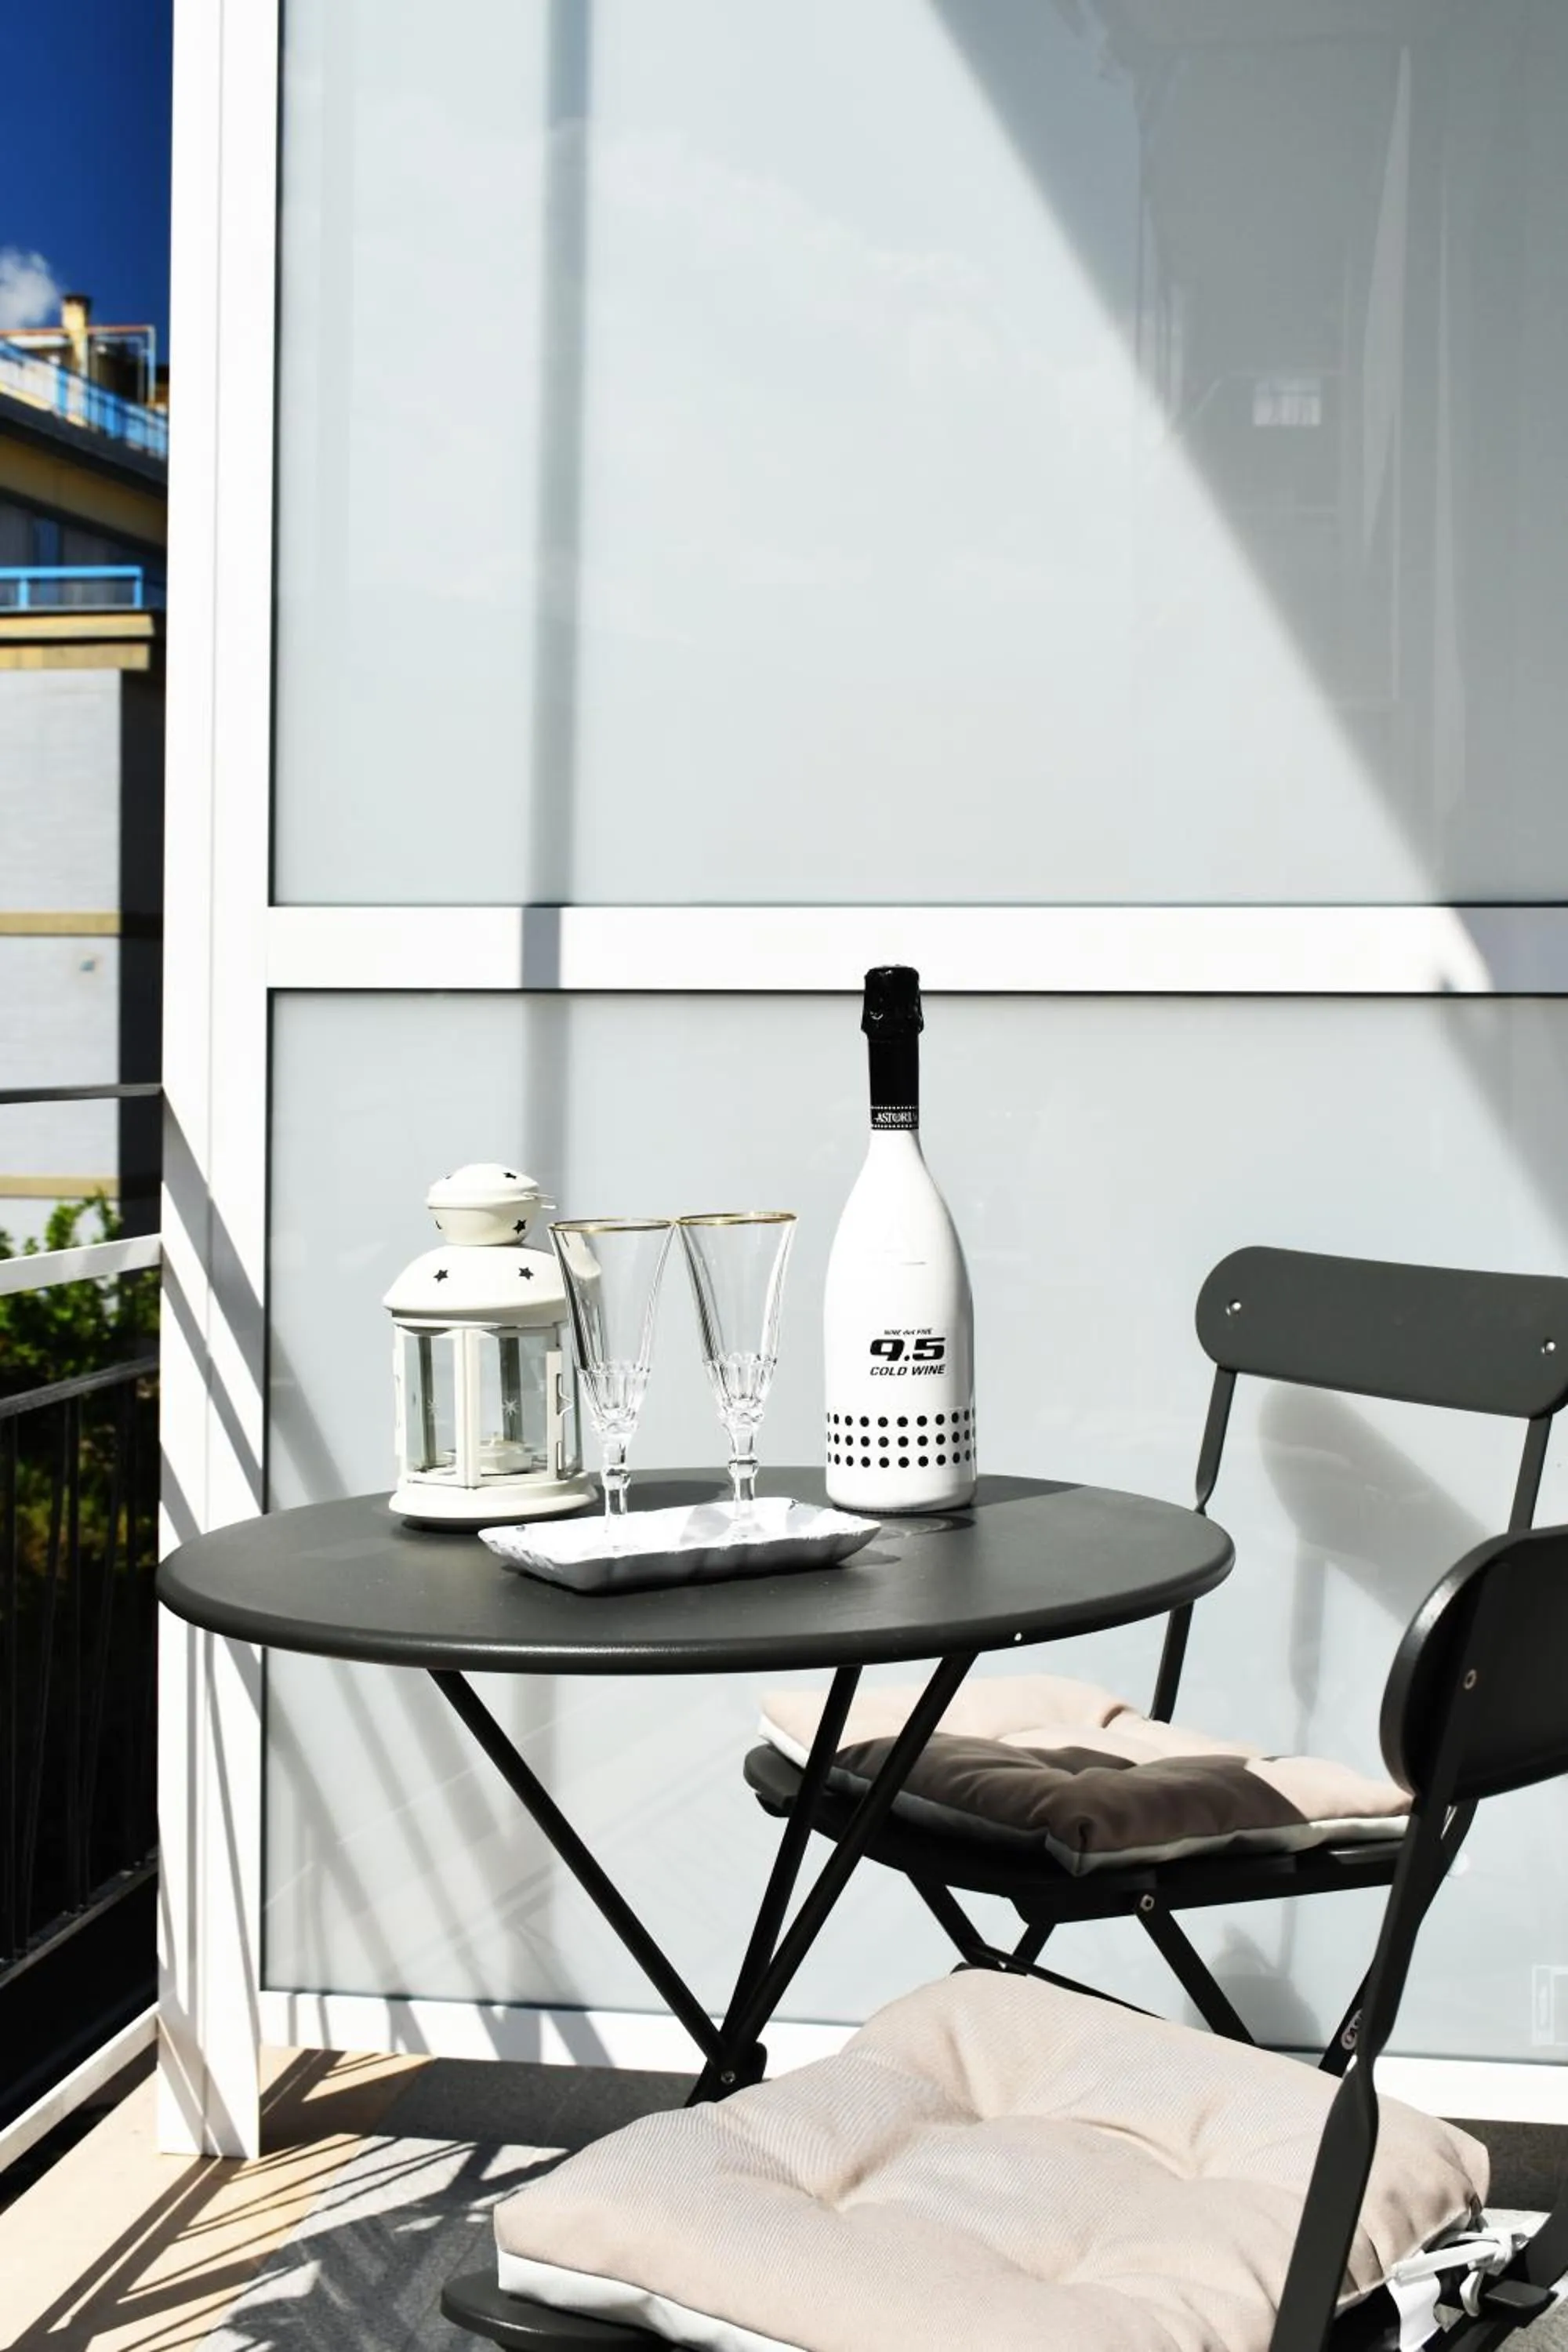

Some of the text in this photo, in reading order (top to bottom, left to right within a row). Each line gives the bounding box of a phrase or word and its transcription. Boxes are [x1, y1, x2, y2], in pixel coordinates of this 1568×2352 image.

[870, 1338, 946, 1361] 9.5
[870, 1364, 945, 1375] COLD WINE
